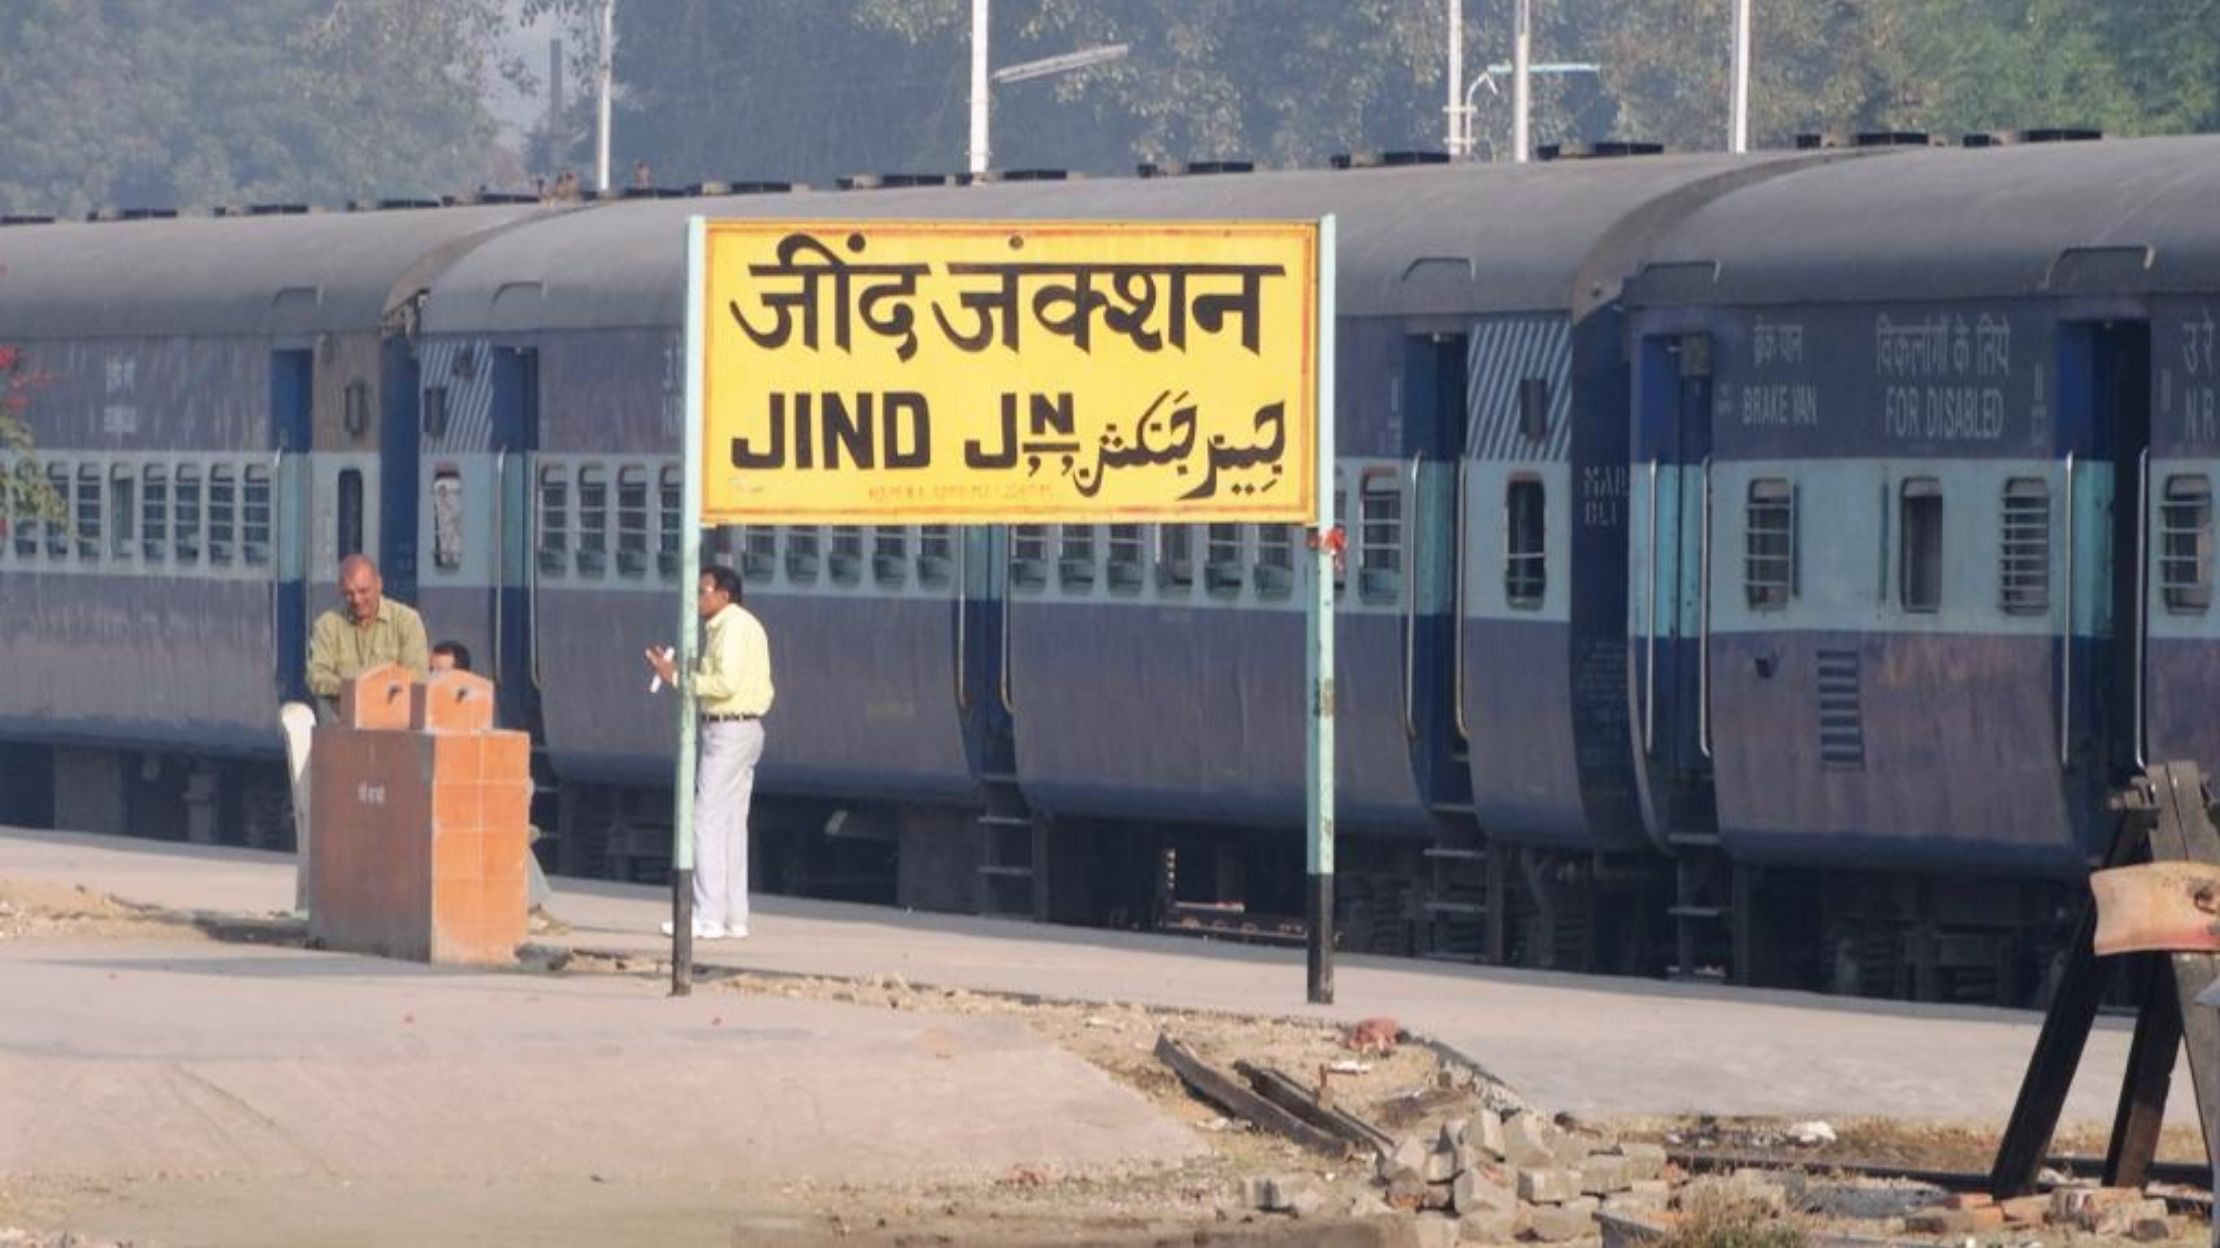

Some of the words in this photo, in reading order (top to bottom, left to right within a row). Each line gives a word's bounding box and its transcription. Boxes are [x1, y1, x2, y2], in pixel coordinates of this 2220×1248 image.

[730, 233, 931, 361] जींद
[932, 235, 1286, 355] जंक्शन
[1953, 312, 1970, 376] के
[732, 392, 931, 469] JIND
[1742, 384, 1788, 425] BRAKE
[1791, 382, 1818, 425] VAN
[1886, 386, 1921, 439] FOR
[1927, 386, 2004, 440] DISABLED
